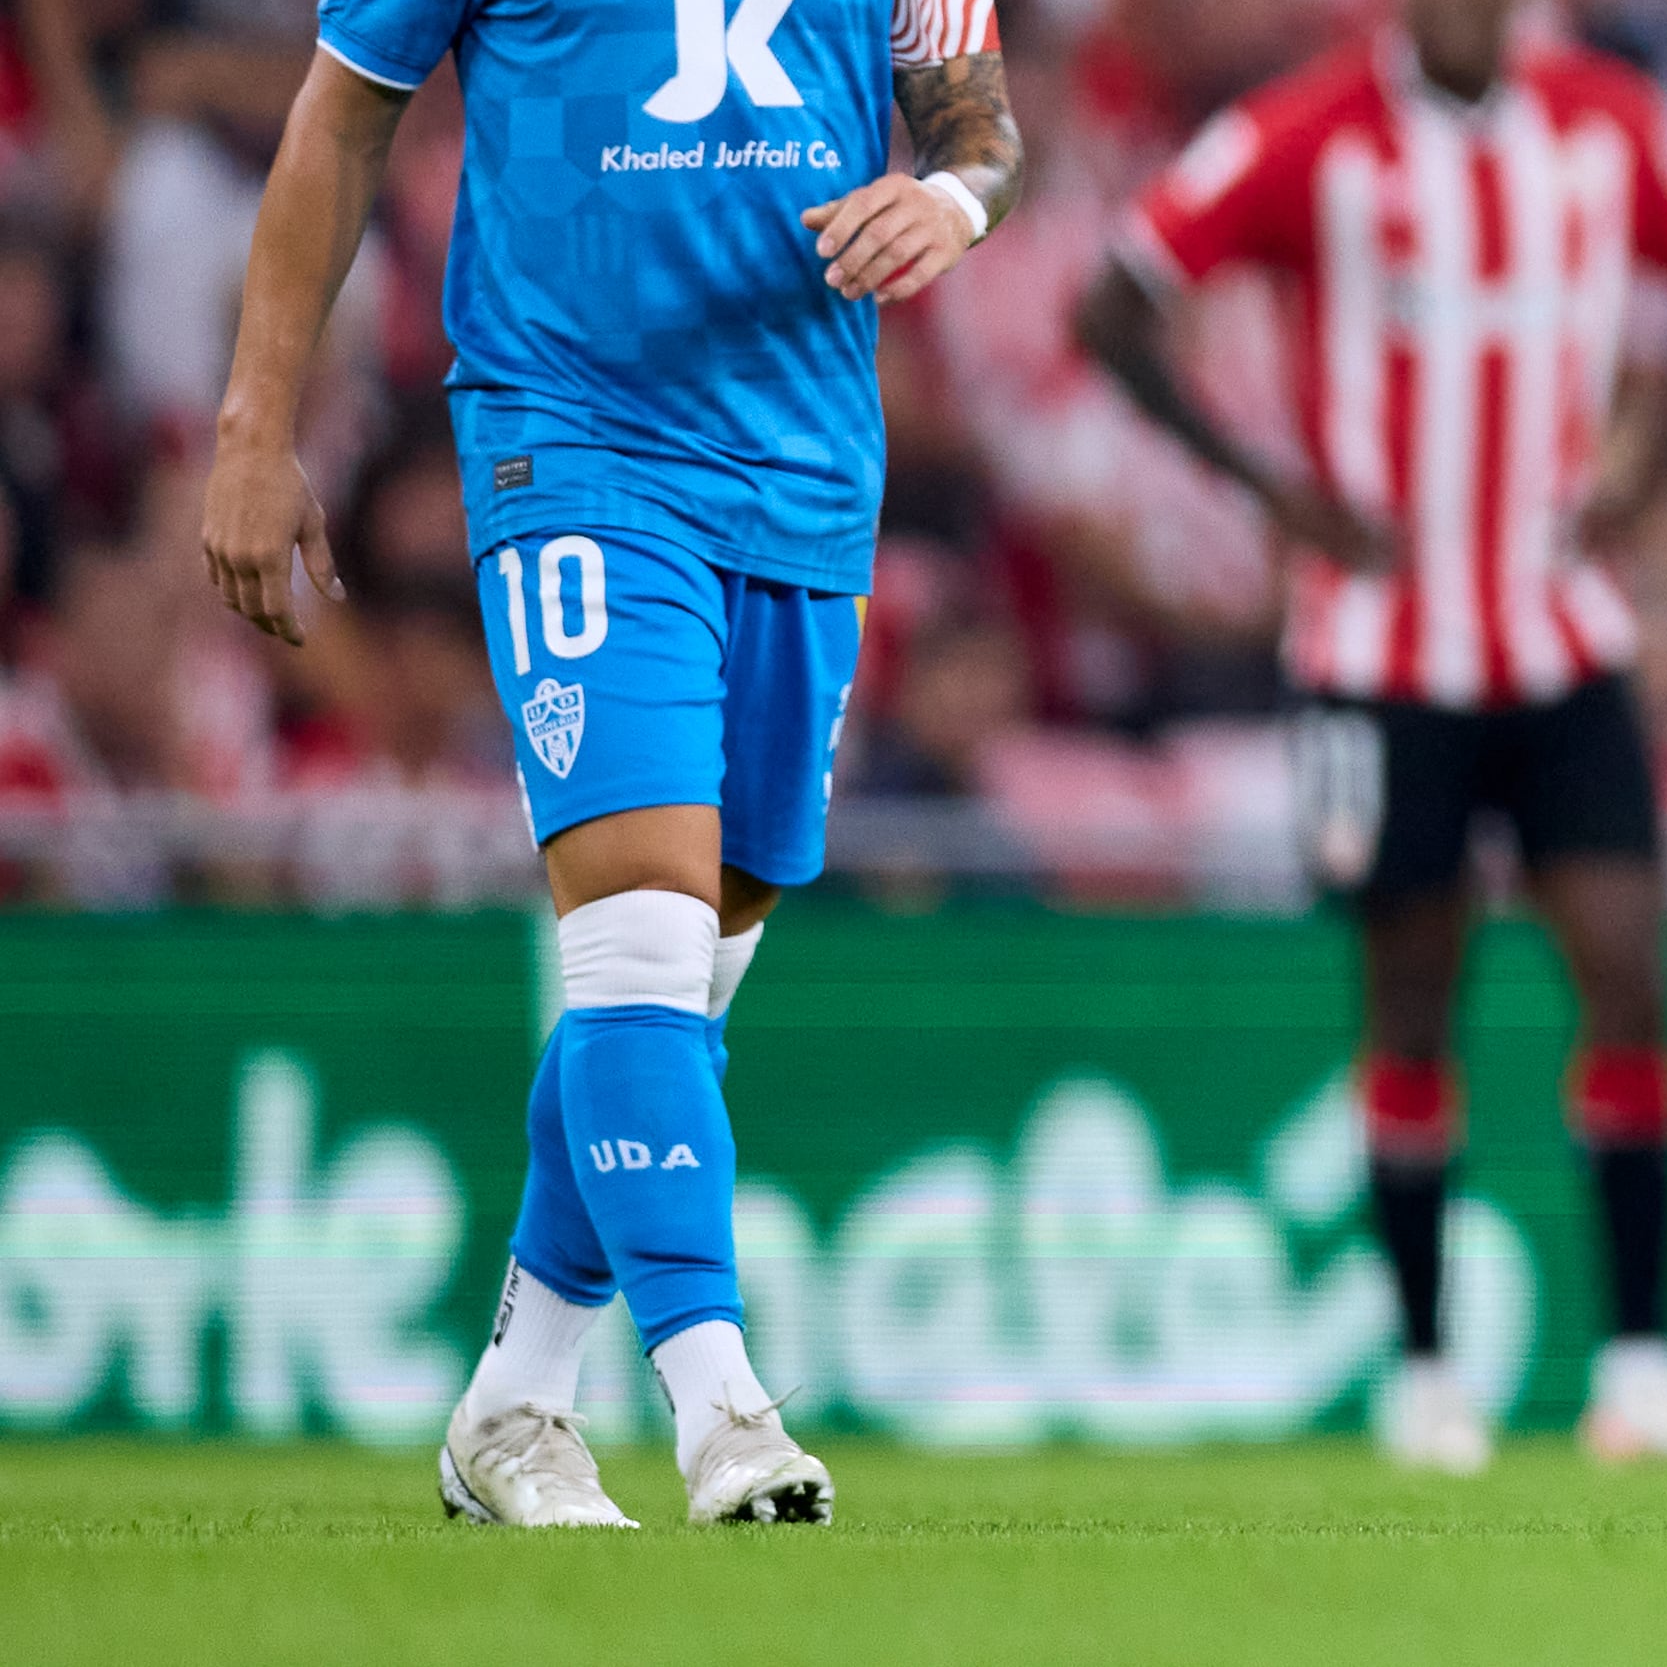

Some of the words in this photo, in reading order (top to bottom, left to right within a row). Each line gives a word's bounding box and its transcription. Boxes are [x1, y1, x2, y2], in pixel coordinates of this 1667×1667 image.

[600, 141, 705, 172] Khaled
[712, 140, 802, 168] Juffali
[806, 140, 842, 168] Co.
[498, 534, 609, 676] 10
